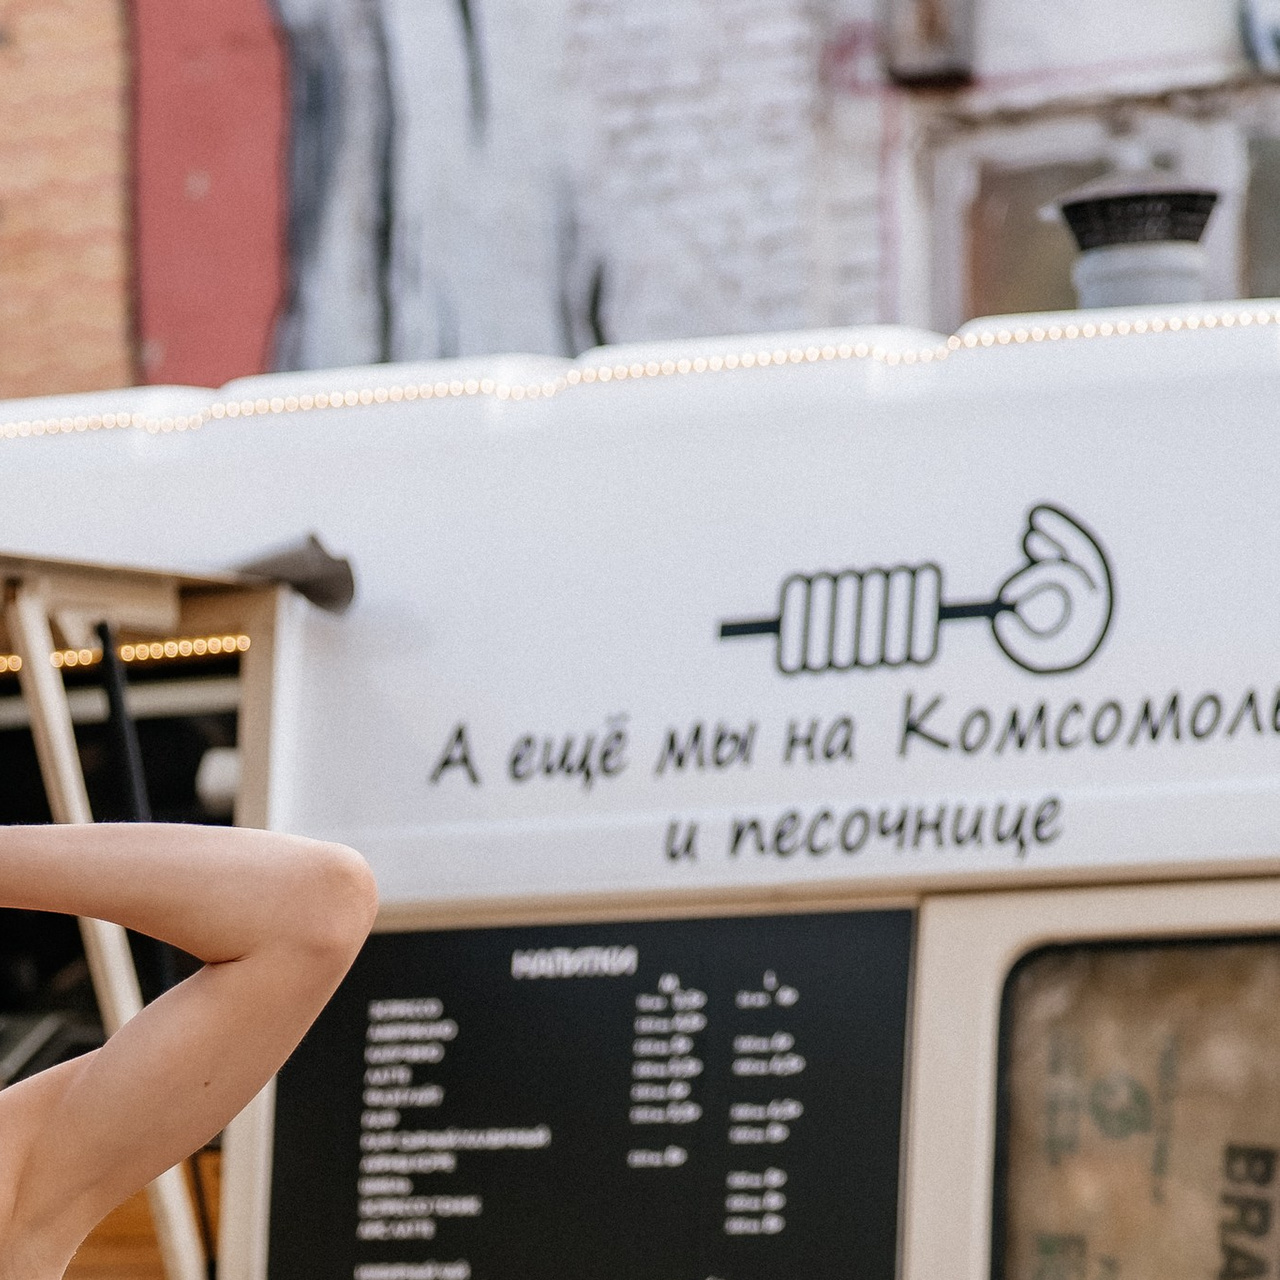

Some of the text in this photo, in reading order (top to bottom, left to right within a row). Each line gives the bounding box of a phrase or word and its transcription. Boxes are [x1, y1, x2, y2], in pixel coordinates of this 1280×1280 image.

[426, 720, 482, 787] А
[508, 711, 631, 792] ещё
[655, 717, 757, 777] мы
[782, 713, 856, 766] на
[663, 793, 1064, 863] и песочнице
